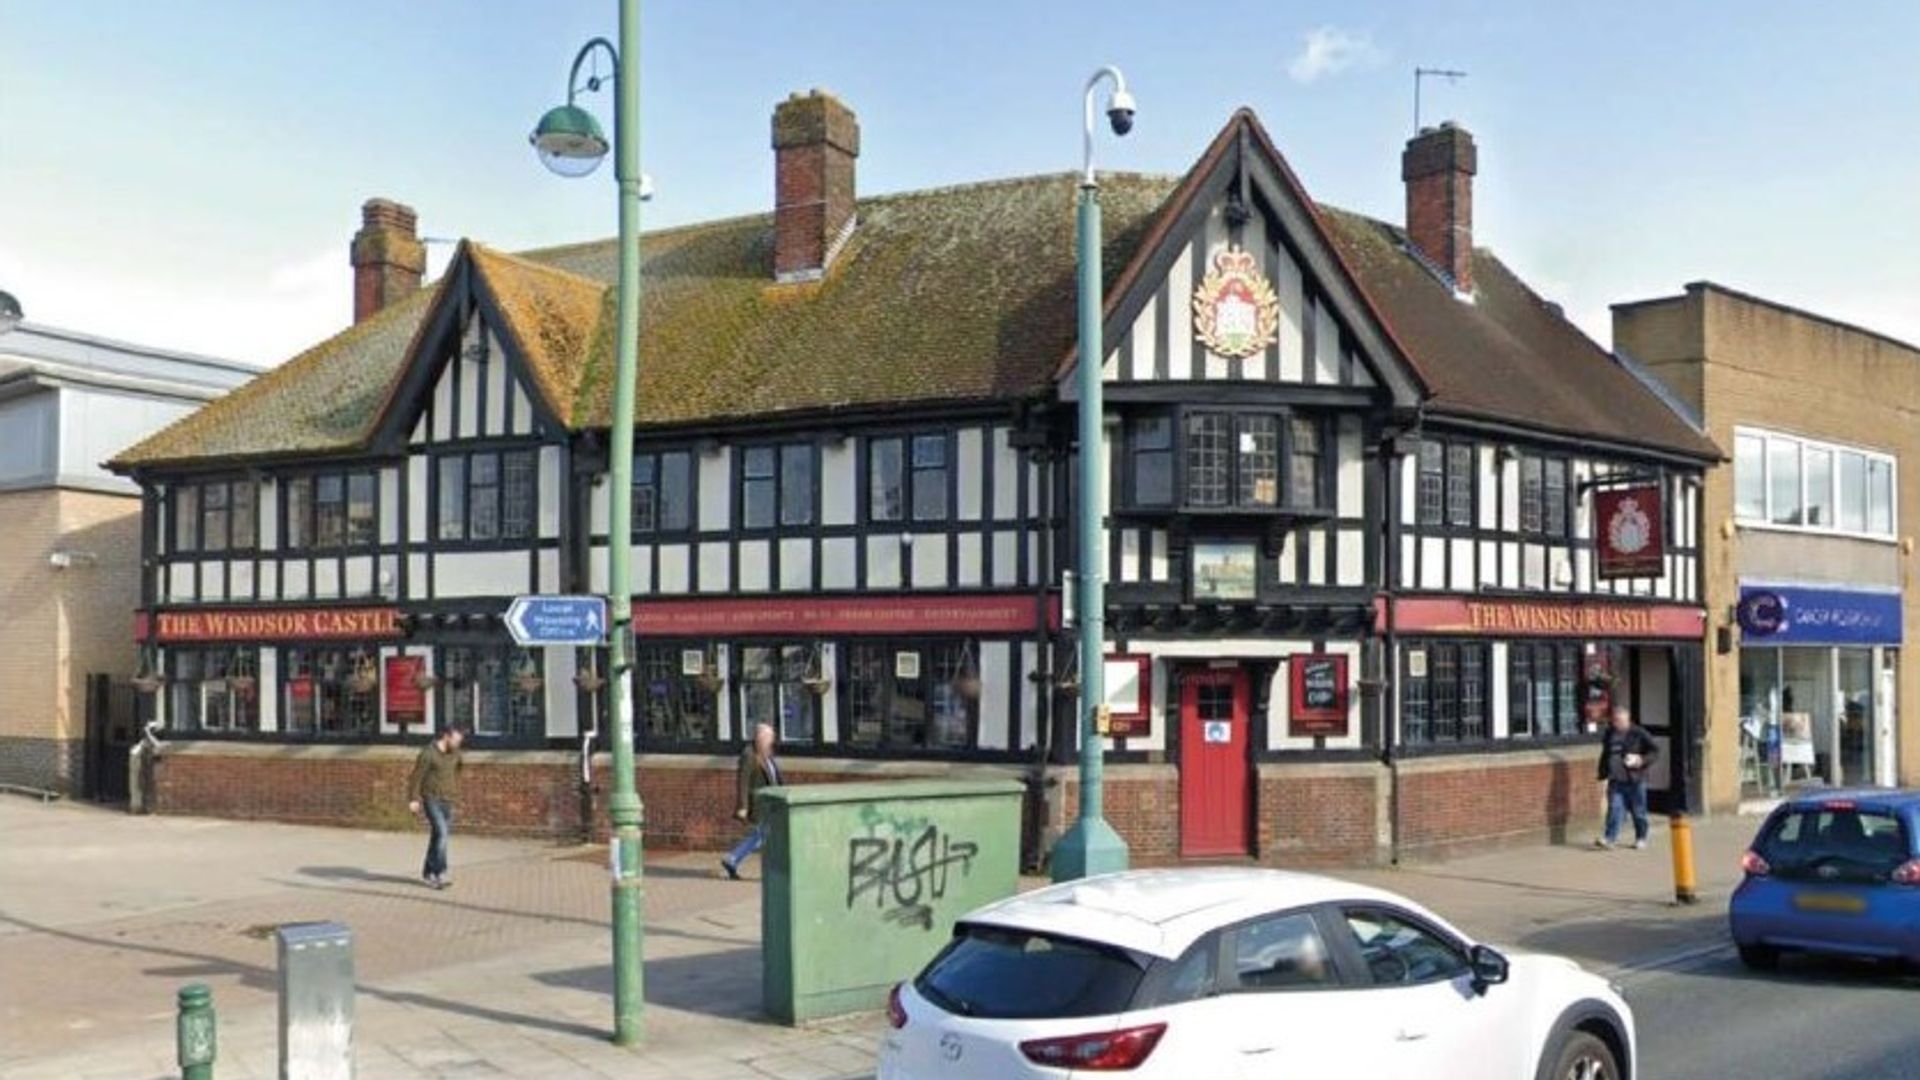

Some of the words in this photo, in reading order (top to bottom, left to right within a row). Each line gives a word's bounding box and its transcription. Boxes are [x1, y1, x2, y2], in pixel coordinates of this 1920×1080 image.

[159, 612, 200, 634] THE
[204, 611, 308, 635] WINDSOR
[1469, 602, 1507, 629] THE
[1511, 604, 1597, 632] WINDSOR
[1599, 607, 1659, 633] CASTLE
